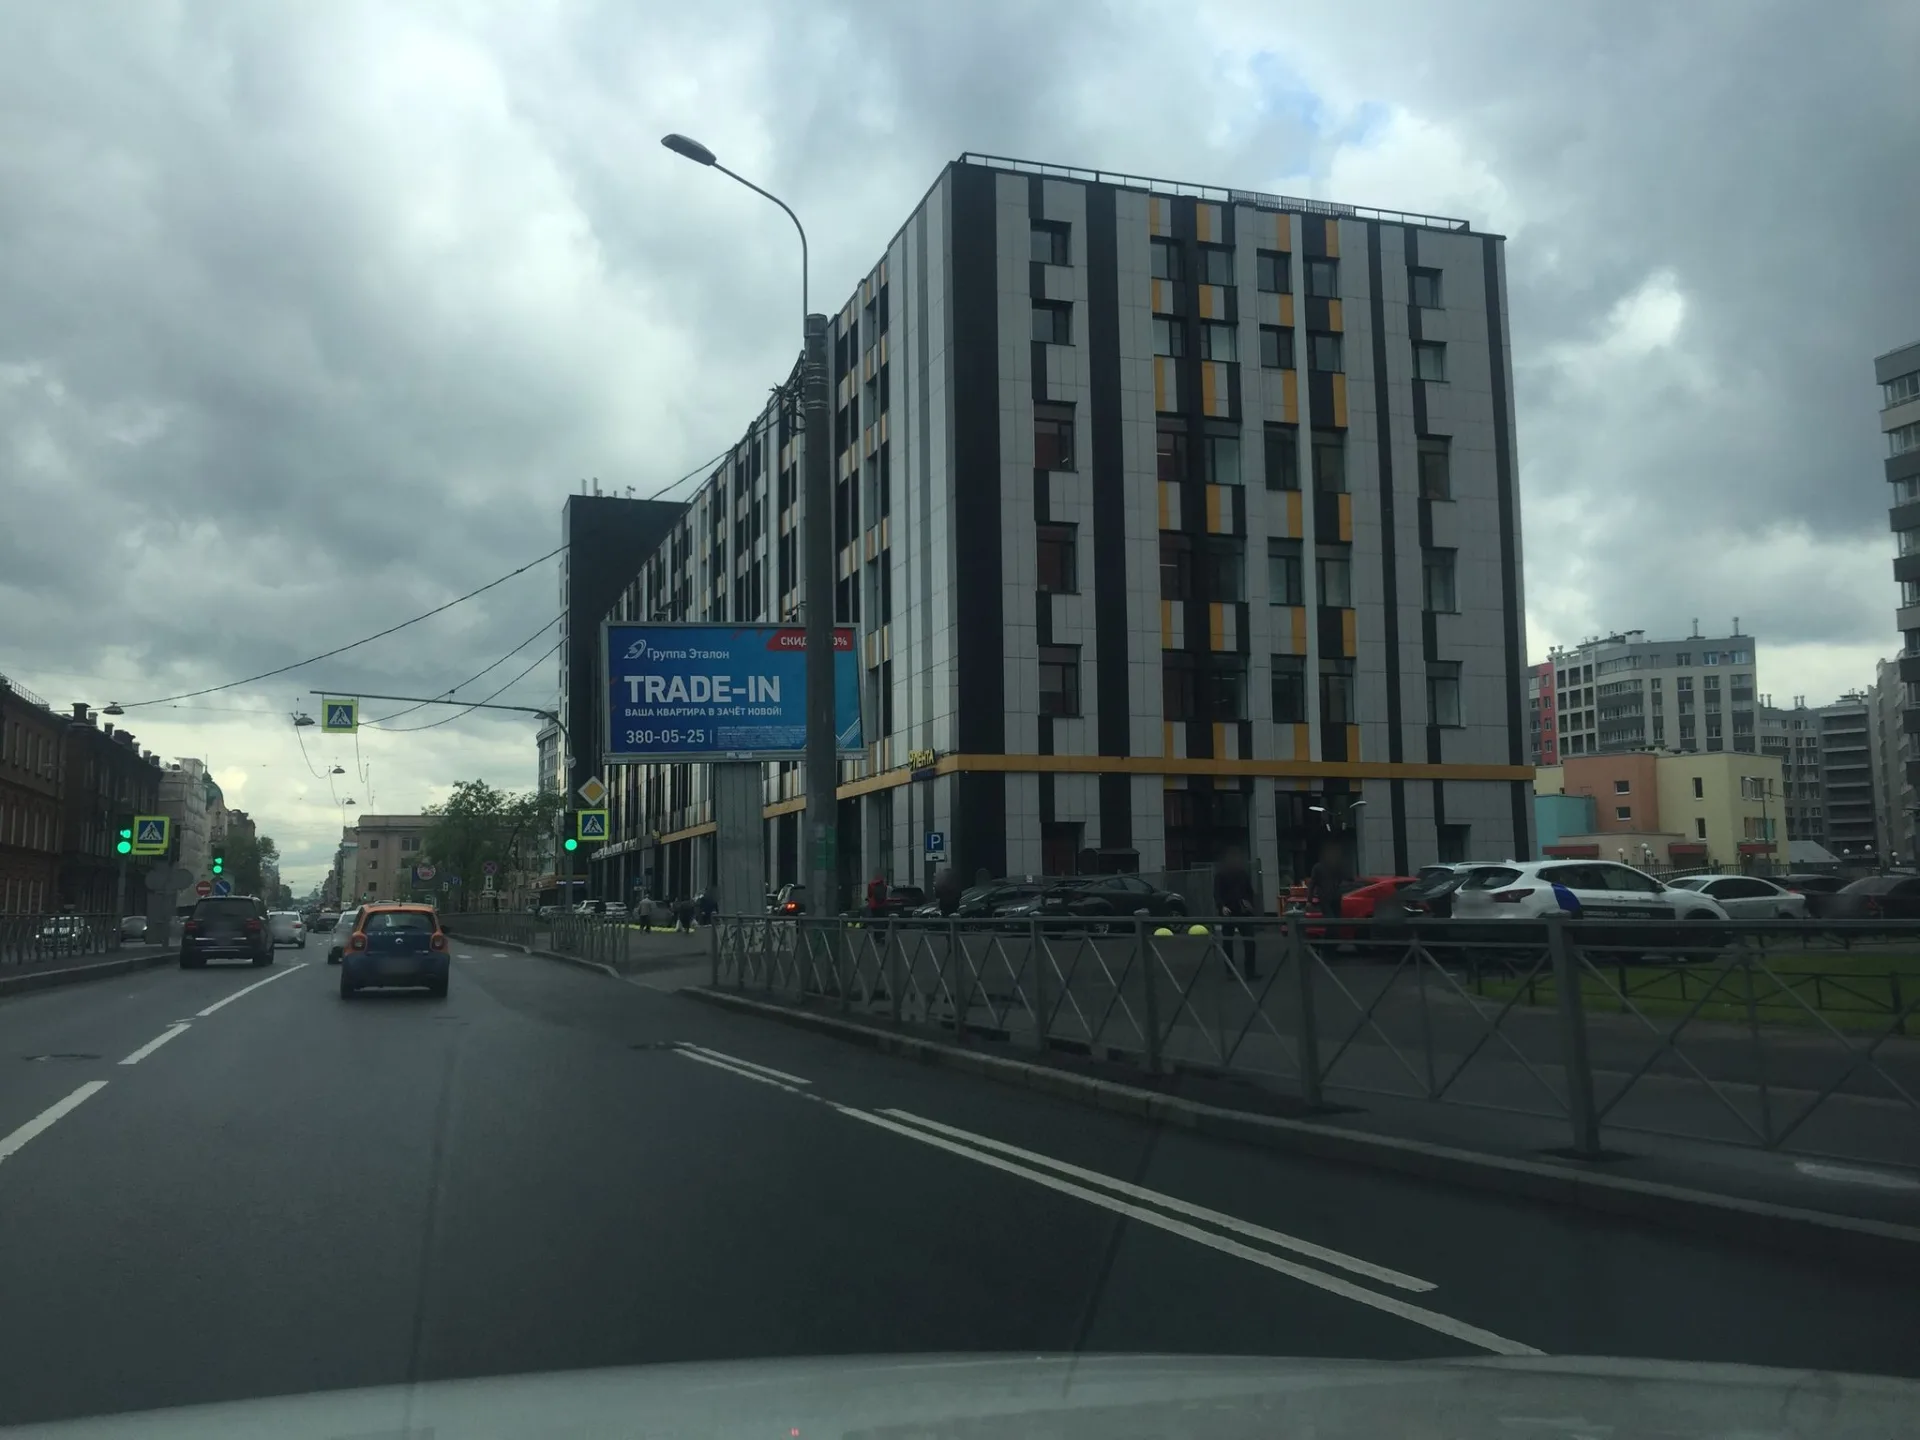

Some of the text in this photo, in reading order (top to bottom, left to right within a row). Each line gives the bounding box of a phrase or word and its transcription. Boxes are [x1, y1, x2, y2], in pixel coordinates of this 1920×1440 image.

[780, 636, 807, 647] СКИД
[647, 648, 730, 661] Группа Эталон
[623, 675, 781, 703] TRADE-IN
[625, 706, 782, 717] ВАША КВАРТИРА В ЗАЧЁТ НОВОЙ!
[626, 730, 705, 744] 380-05-25
